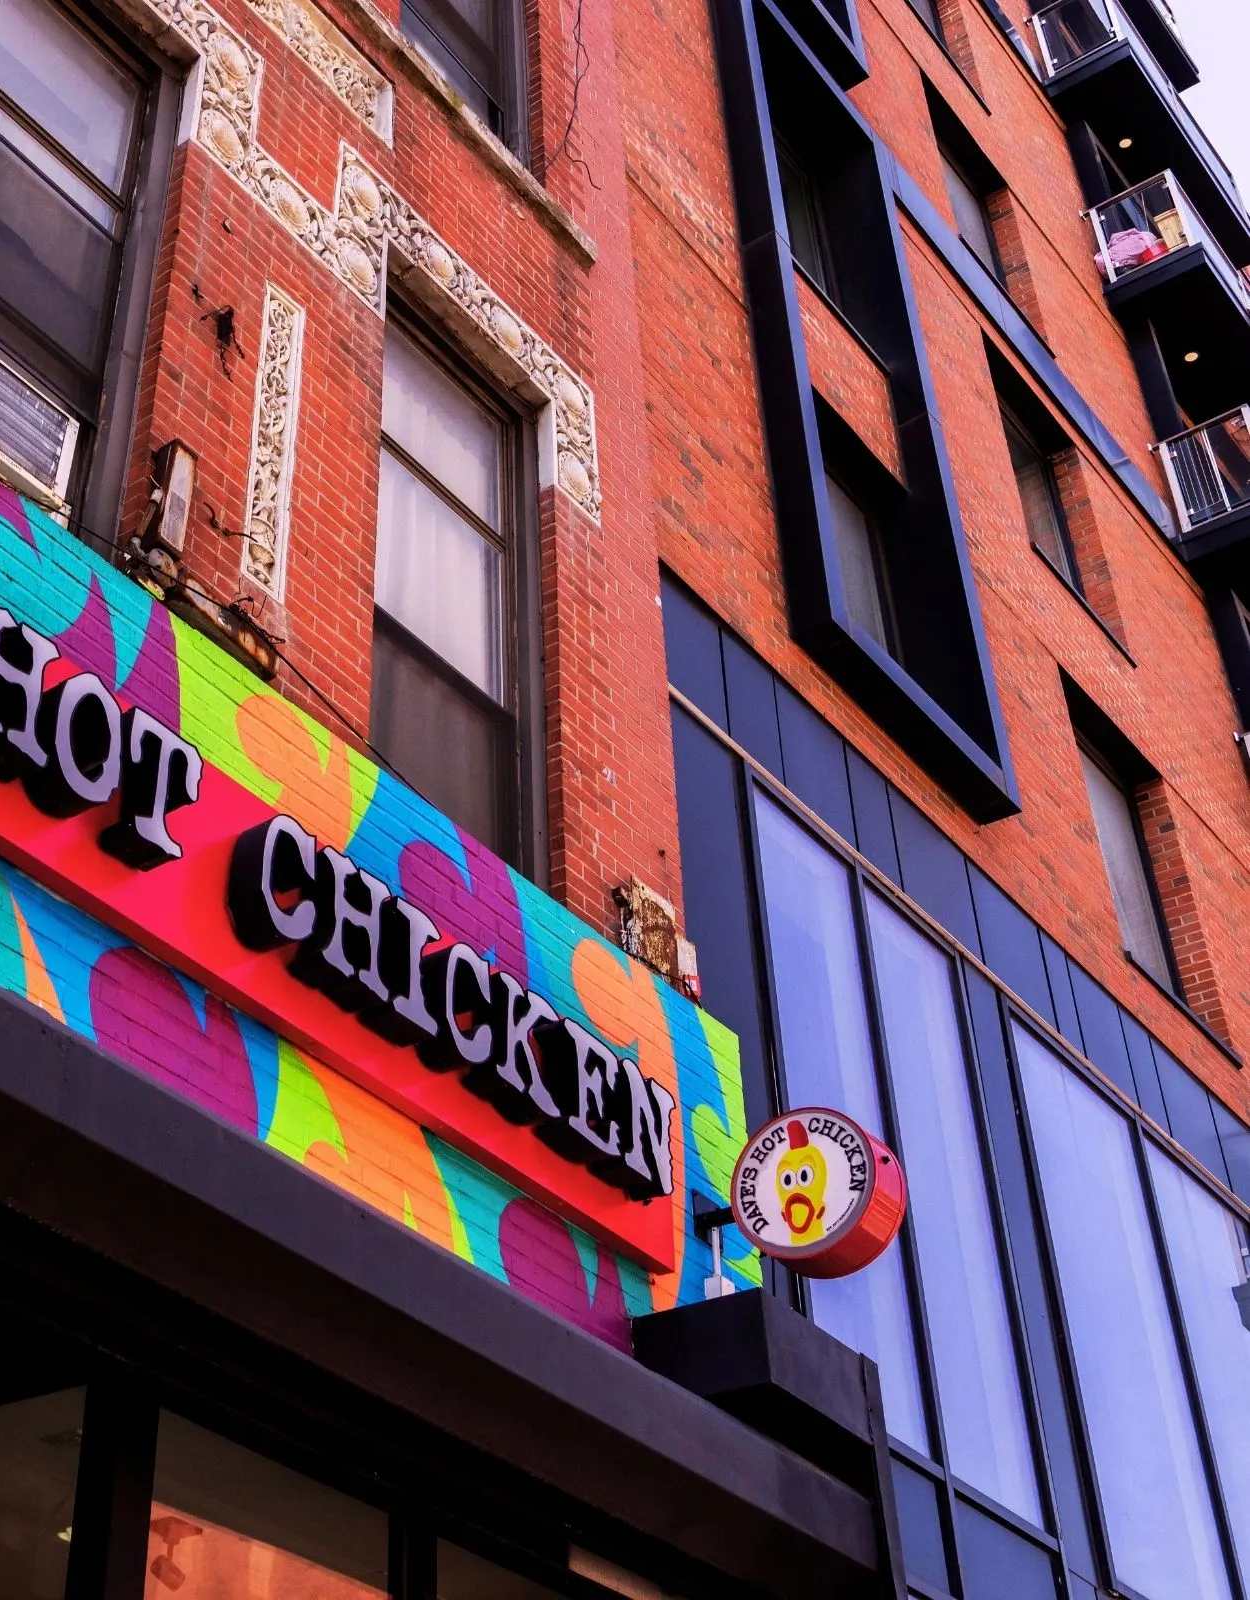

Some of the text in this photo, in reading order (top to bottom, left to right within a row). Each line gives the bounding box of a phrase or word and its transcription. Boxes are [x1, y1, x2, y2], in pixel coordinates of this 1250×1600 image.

[256, 814, 677, 1198] CHICKEN
[750, 1126, 787, 1164] HOT
[807, 1117, 867, 1192] CHICKEN
[740, 1167, 770, 1235] DAVE'S
